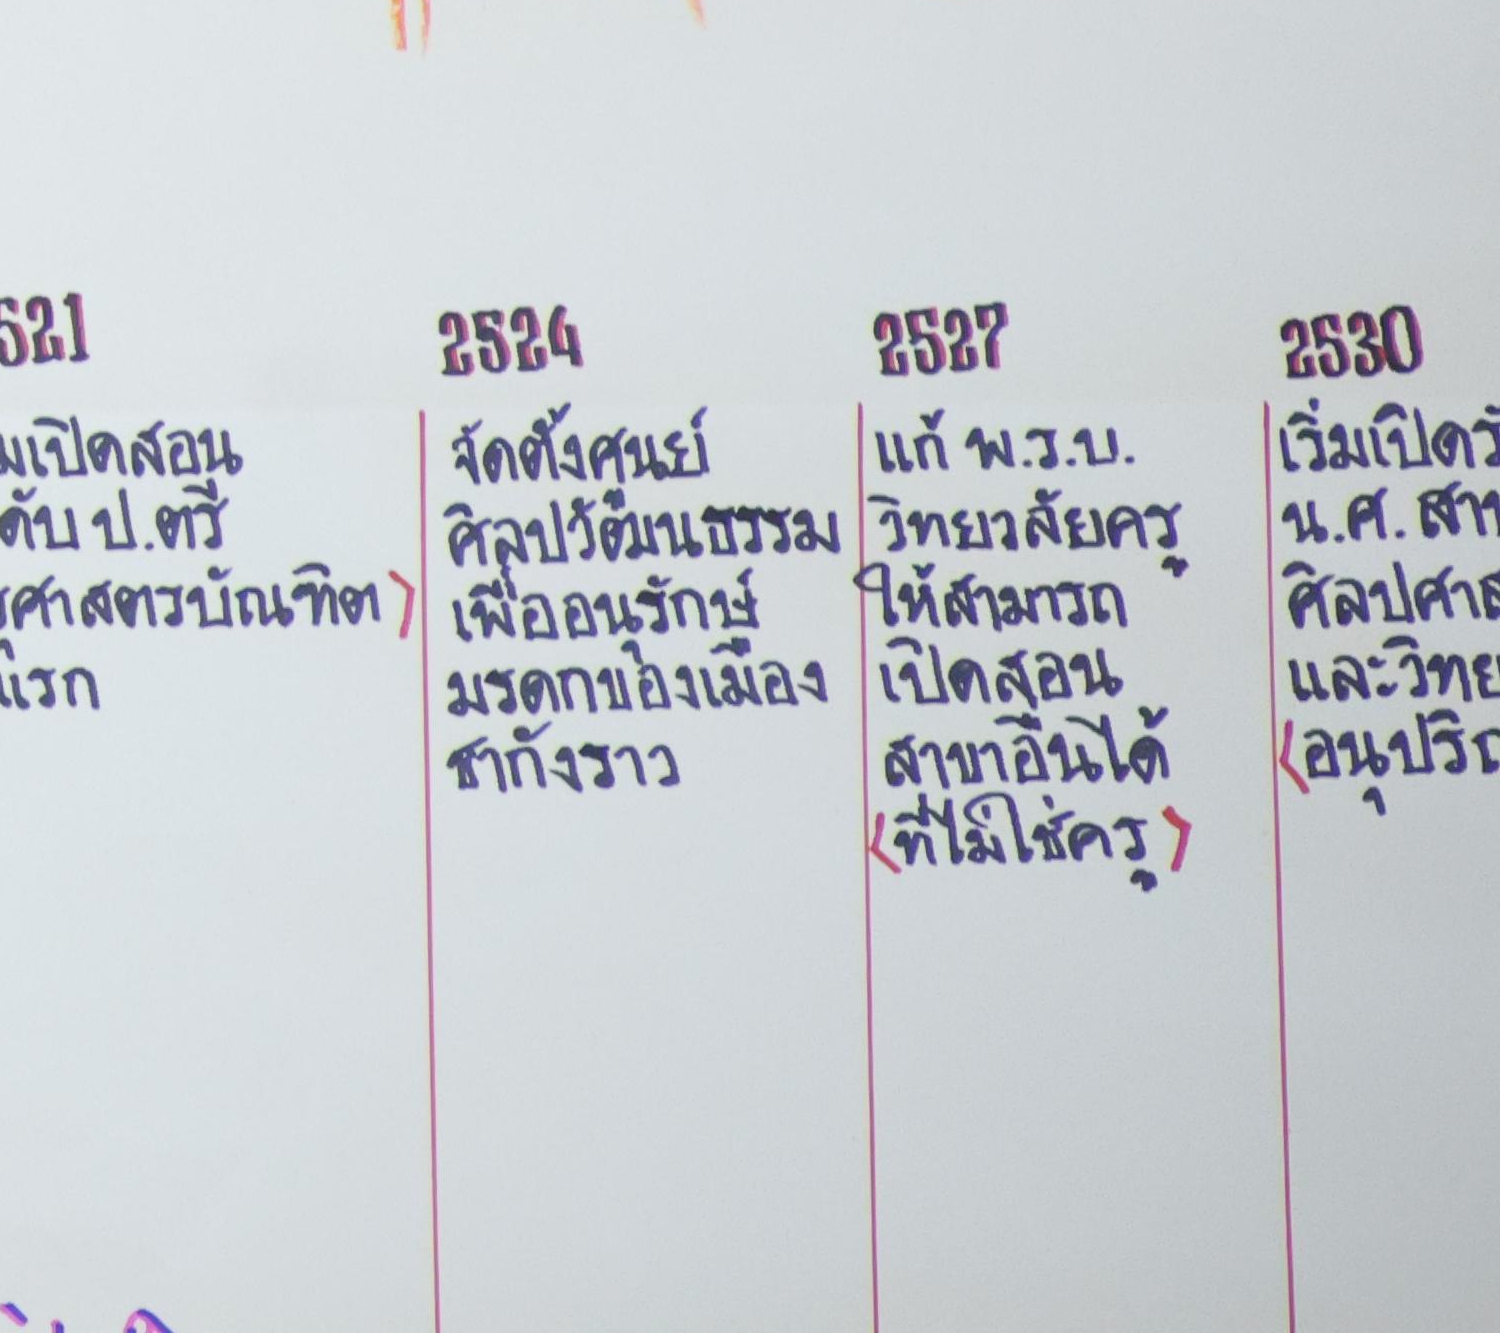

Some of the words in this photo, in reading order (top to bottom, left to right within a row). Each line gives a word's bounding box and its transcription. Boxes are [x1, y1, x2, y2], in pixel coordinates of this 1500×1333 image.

[438, 305, 585, 377] 2524
[873, 301, 1009, 377] 2527
[1280, 304, 1424, 379] 2530
[876, 408, 950, 473] แก้
[965, 427, 1136, 470] พ.ร.บ.
[446, 637, 829, 717] มรดกของเมือง
[879, 636, 1124, 709] เปิดสอน
[446, 721, 681, 793] ชากังราว
